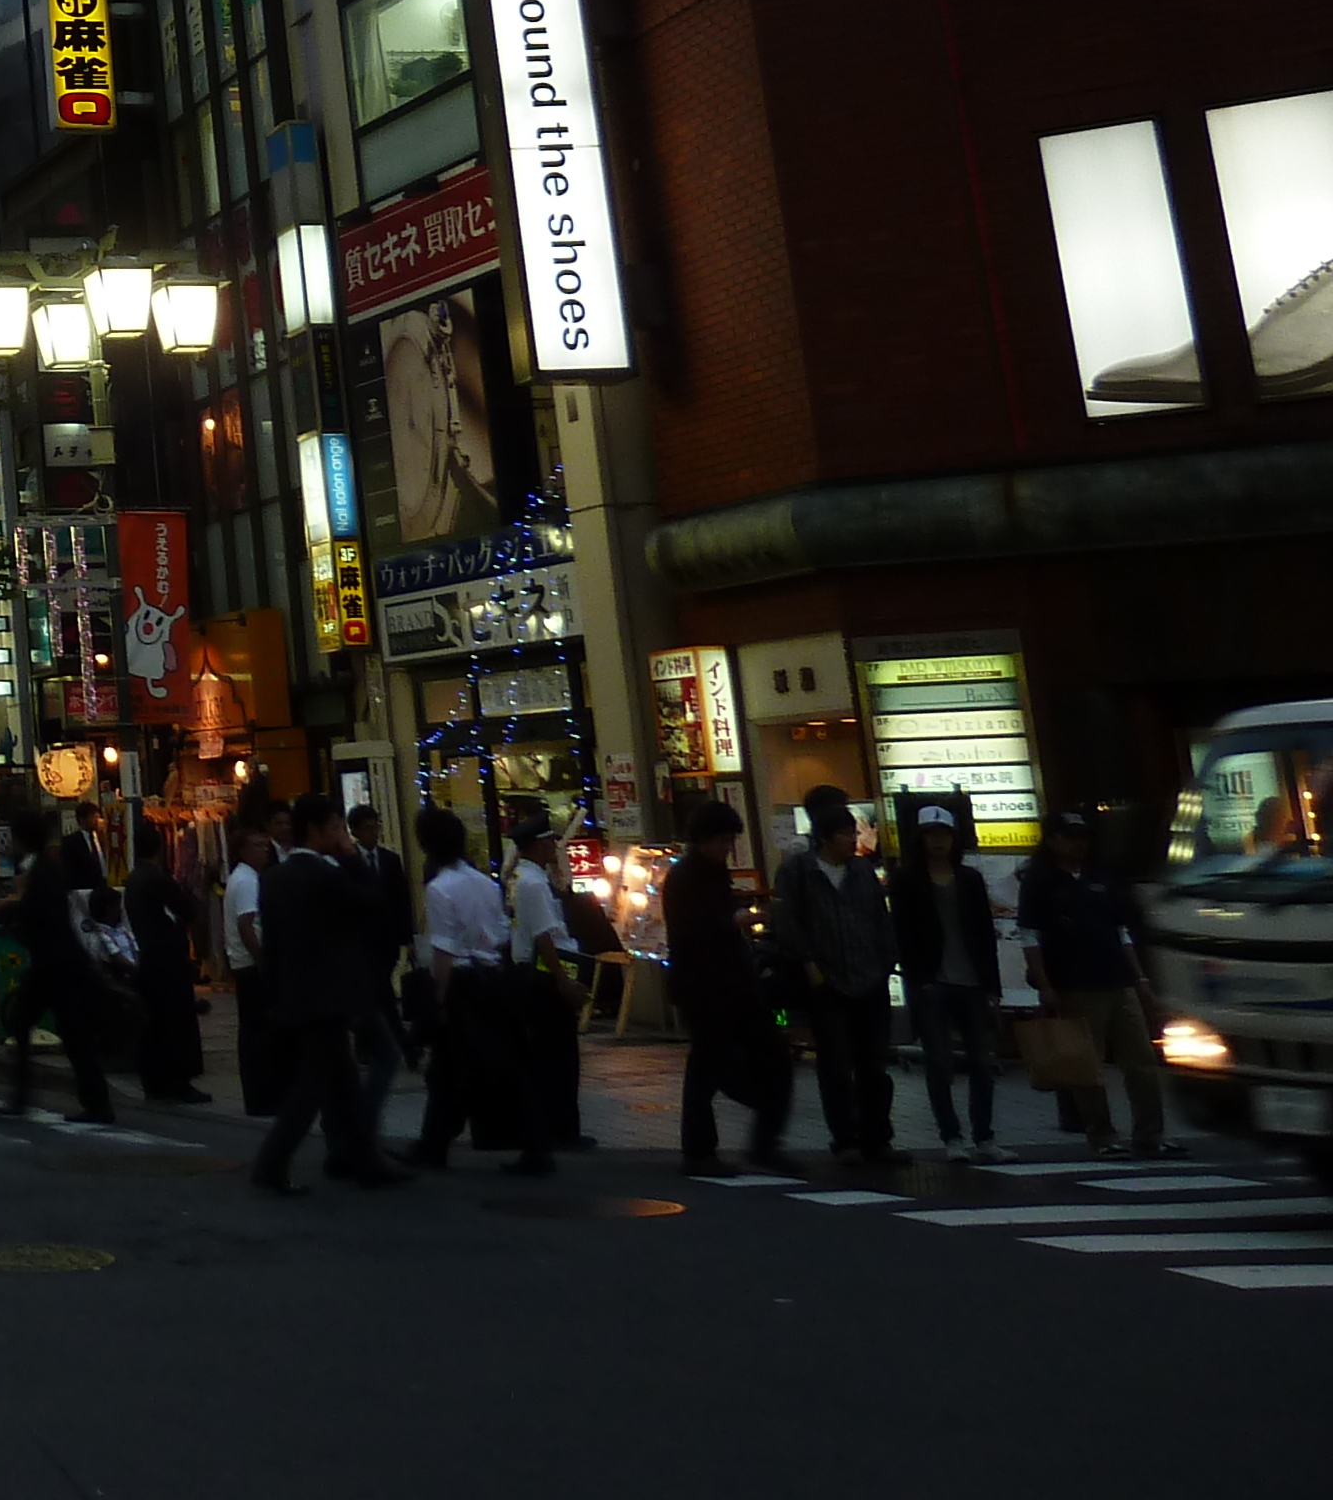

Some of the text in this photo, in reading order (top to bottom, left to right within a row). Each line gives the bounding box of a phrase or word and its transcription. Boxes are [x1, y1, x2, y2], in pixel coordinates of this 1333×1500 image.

[52, 18, 110, 91] 麻雀
[535, 122, 574, 199] the
[344, 221, 422, 293] 質セキネ
[547, 213, 591, 352] shoes
[334, 471, 350, 532] Nail salon
[338, 547, 357, 563] 3F
[339, 565, 364, 620] 麻雀
[706, 660, 735, 758] インド料理
[940, 717, 1021, 732] Tiziano
[991, 800, 1033, 812] shoes
